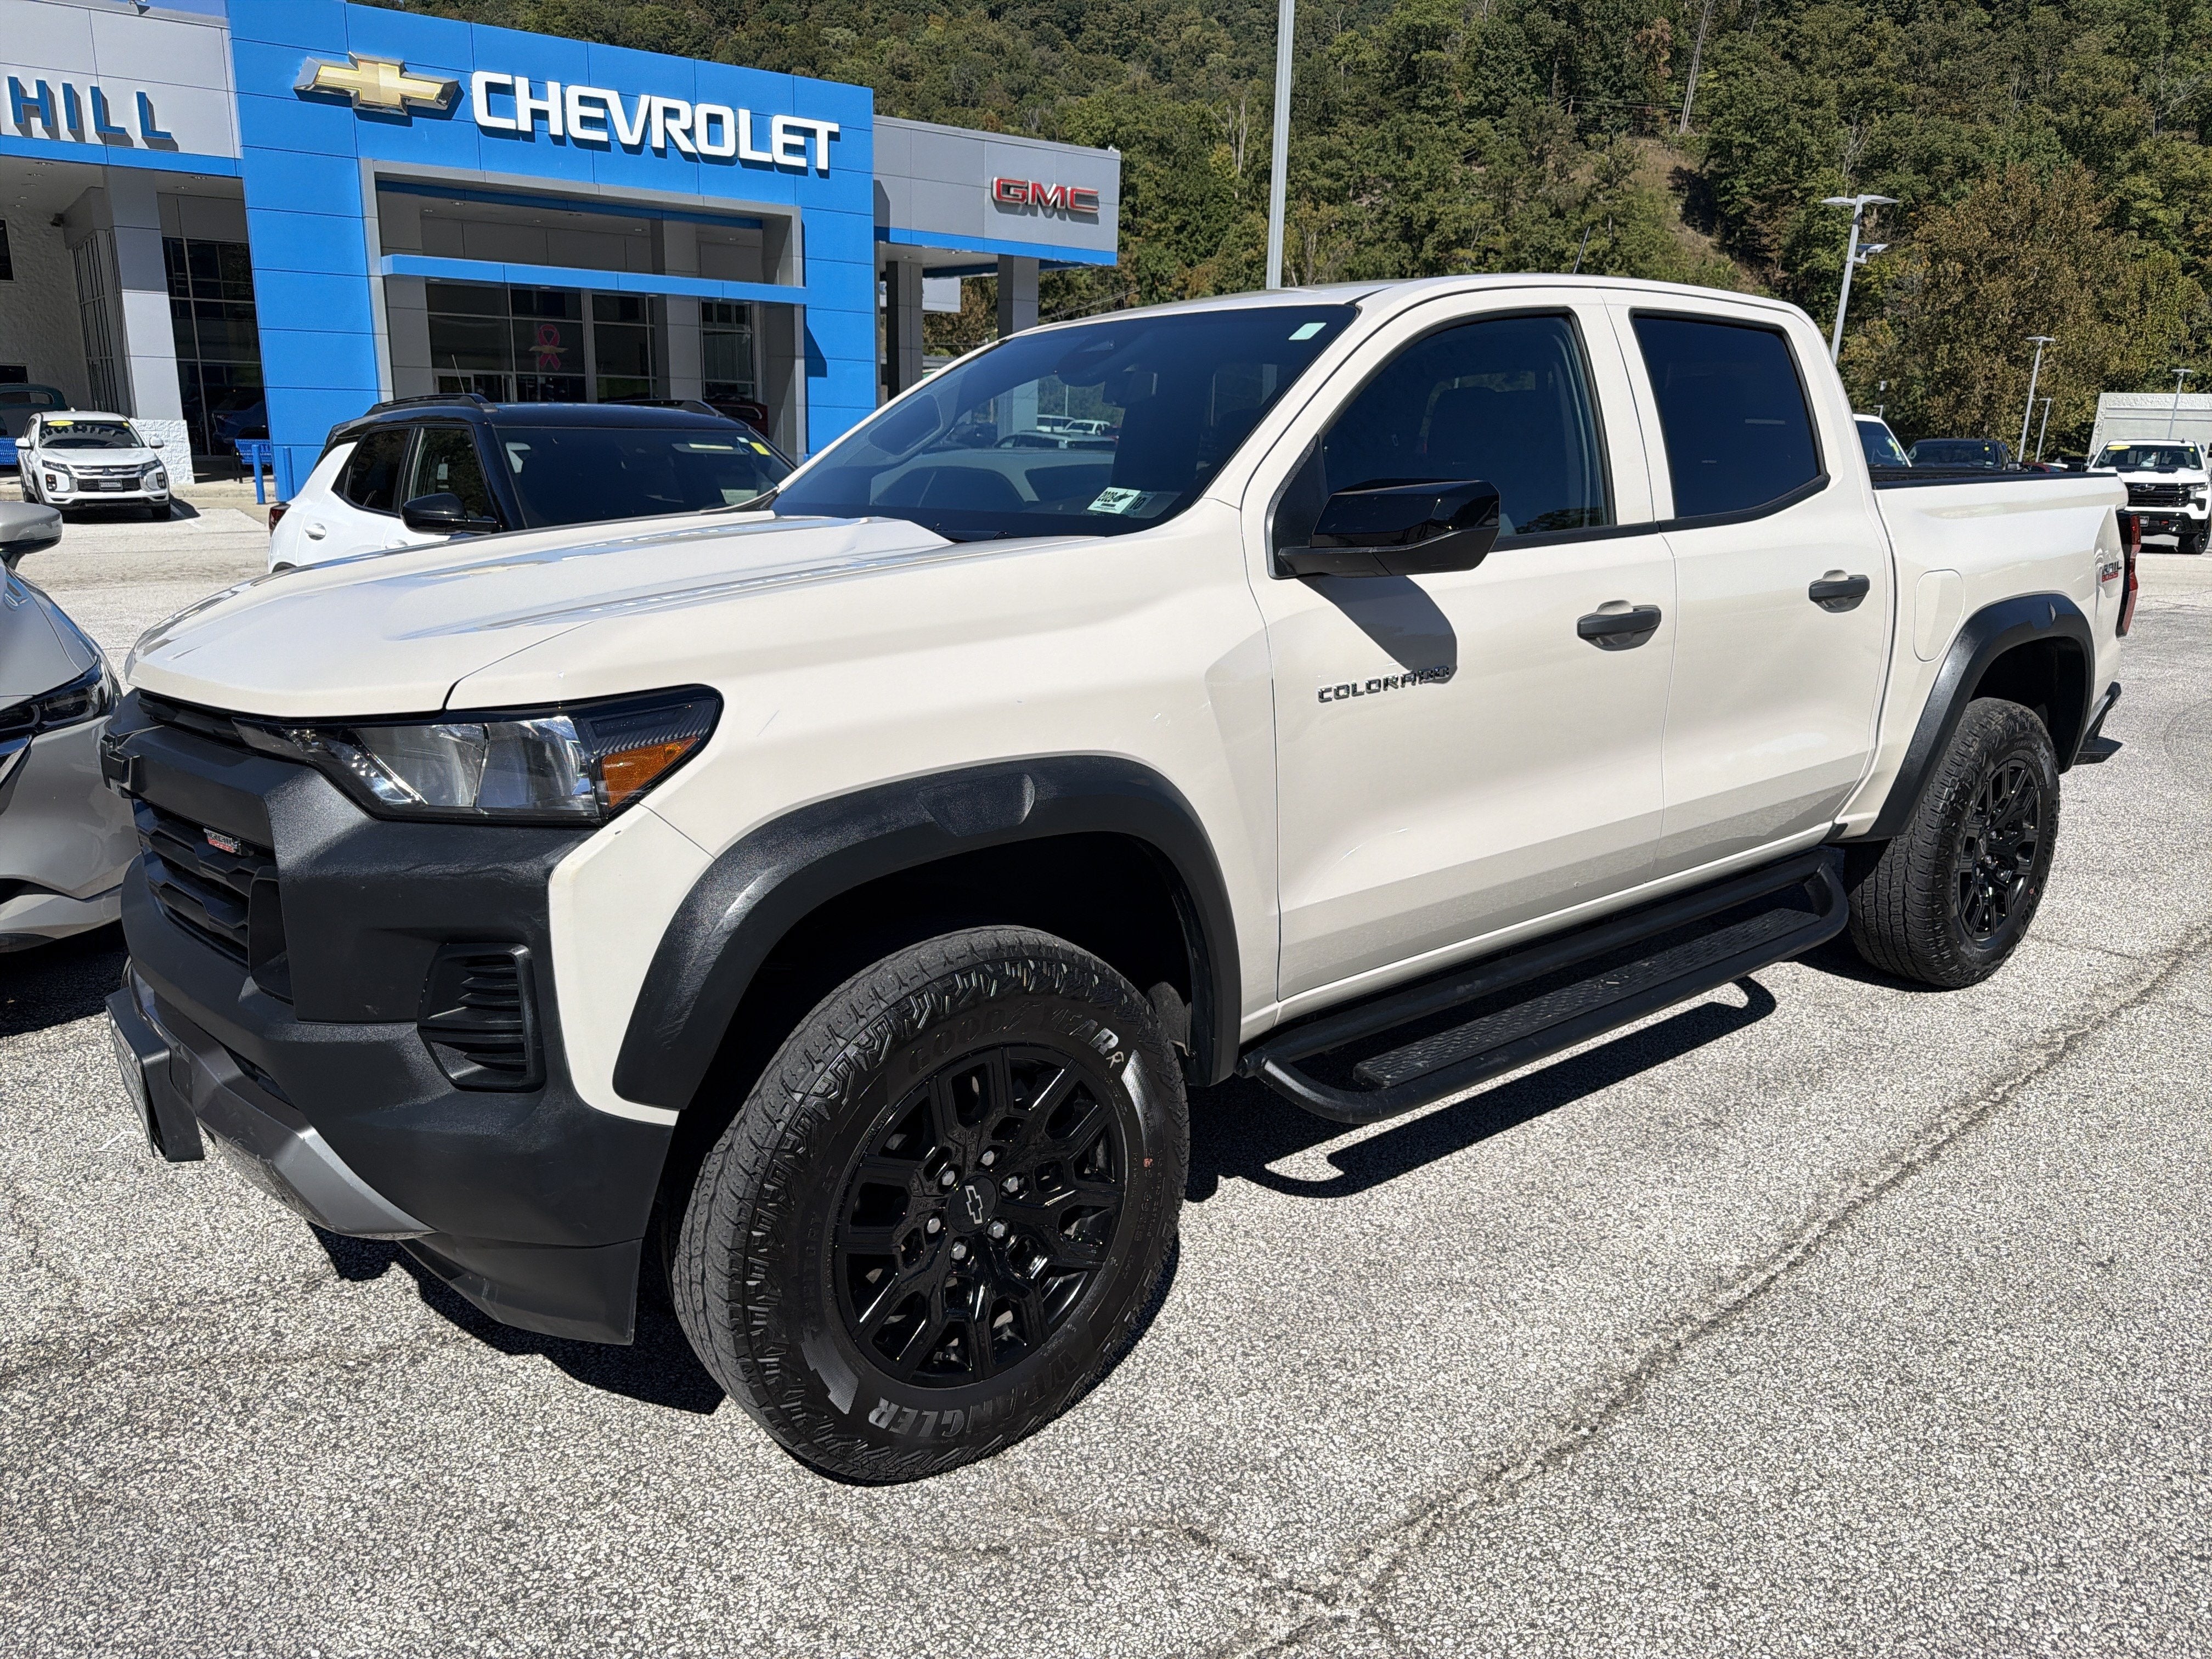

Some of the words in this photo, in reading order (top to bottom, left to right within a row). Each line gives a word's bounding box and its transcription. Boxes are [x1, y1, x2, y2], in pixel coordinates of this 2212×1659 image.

[8, 76, 172, 139] HILL
[471, 71, 839, 171] CHEVROLET
[992, 177, 1099, 215] GMC
[1317, 665, 1449, 703] COLORADO
[868, 1349, 1080, 1438] WRANGLER
